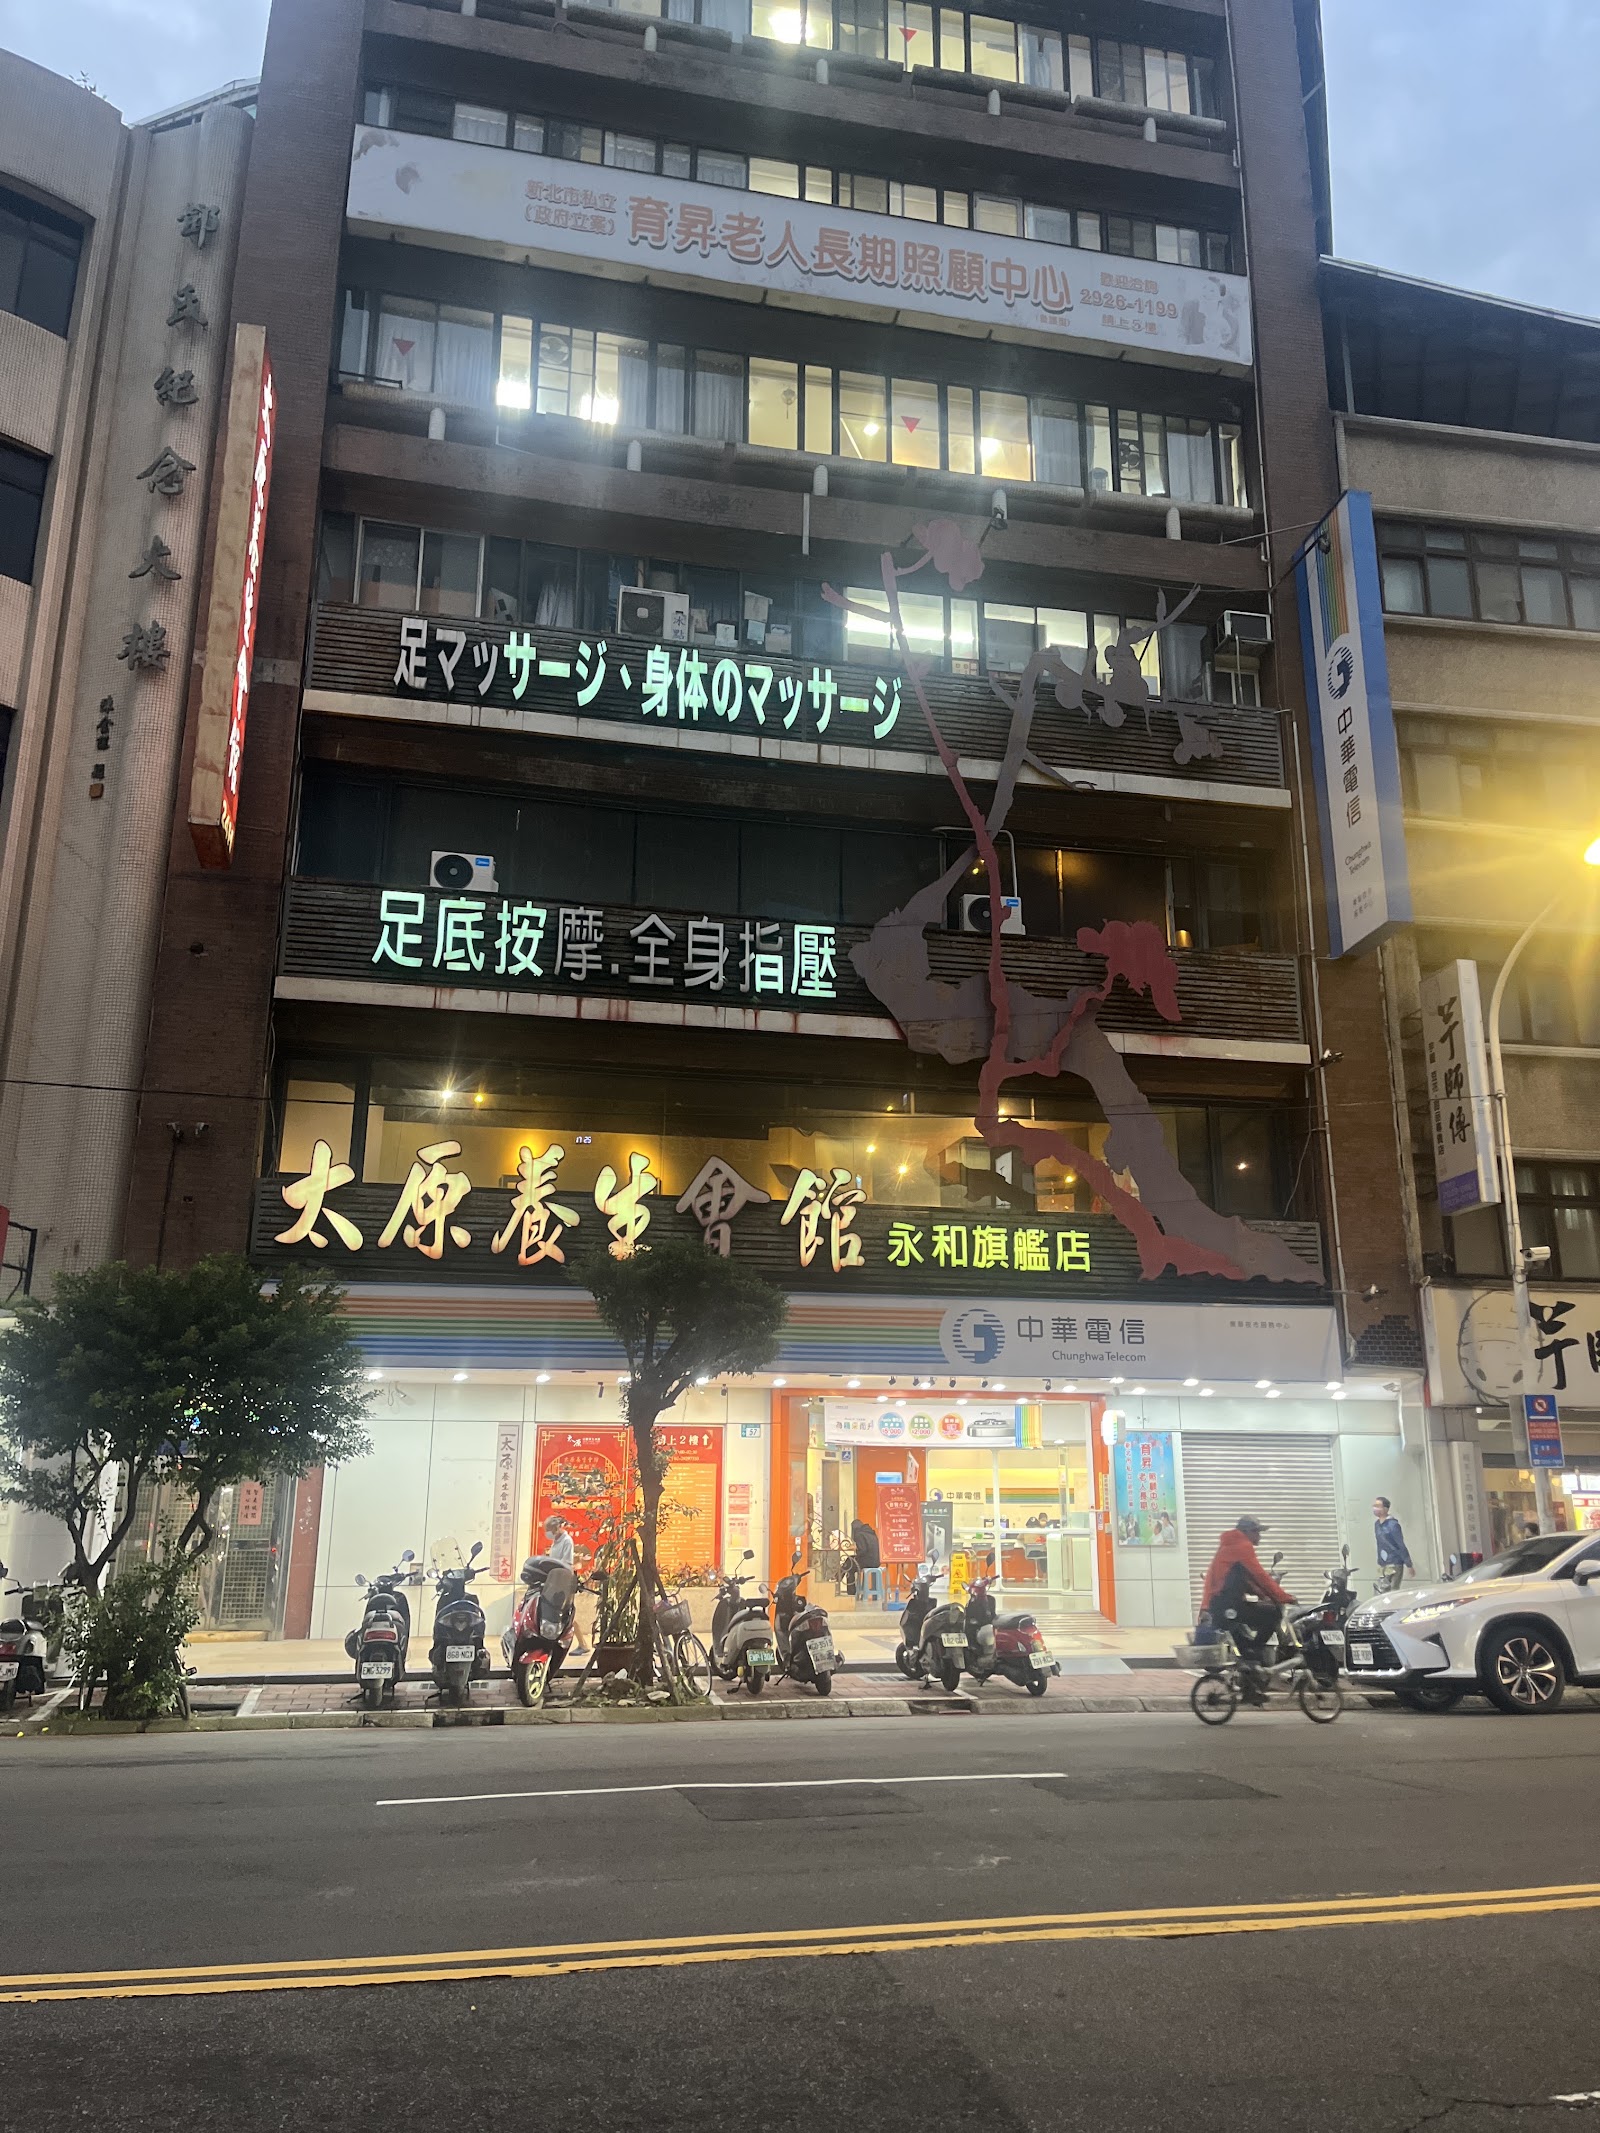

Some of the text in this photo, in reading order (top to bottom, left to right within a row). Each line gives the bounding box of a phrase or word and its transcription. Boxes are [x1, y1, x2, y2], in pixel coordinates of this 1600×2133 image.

[526, 180, 616, 213] 新北市私立
[627, 195, 1073, 313] 育昇老人長期照顧中心
[1080, 288, 1178, 319] 2926-1199
[393, 616, 903, 741] 足マッサージ、身体のマッサージ
[1337, 706, 1362, 829] 中華電信
[1438, 996, 1470, 1144] 芋師傅
[274, 1139, 867, 1273] 太原養生會館
[887, 1221, 1091, 1273] 永和旗艦店
[1017, 1316, 1146, 1345] 中華電信
[1052, 1350, 1146, 1363] Chunghwa Telecom
[1528, 1301, 1600, 1390] 芋
[500, 1437, 515, 1511] 太原養生會館
[1140, 1443, 1152, 1468] 育昇
[946, 1491, 981, 1500] 中華電信
[446, 1650, 473, 1659] 868-NGX
